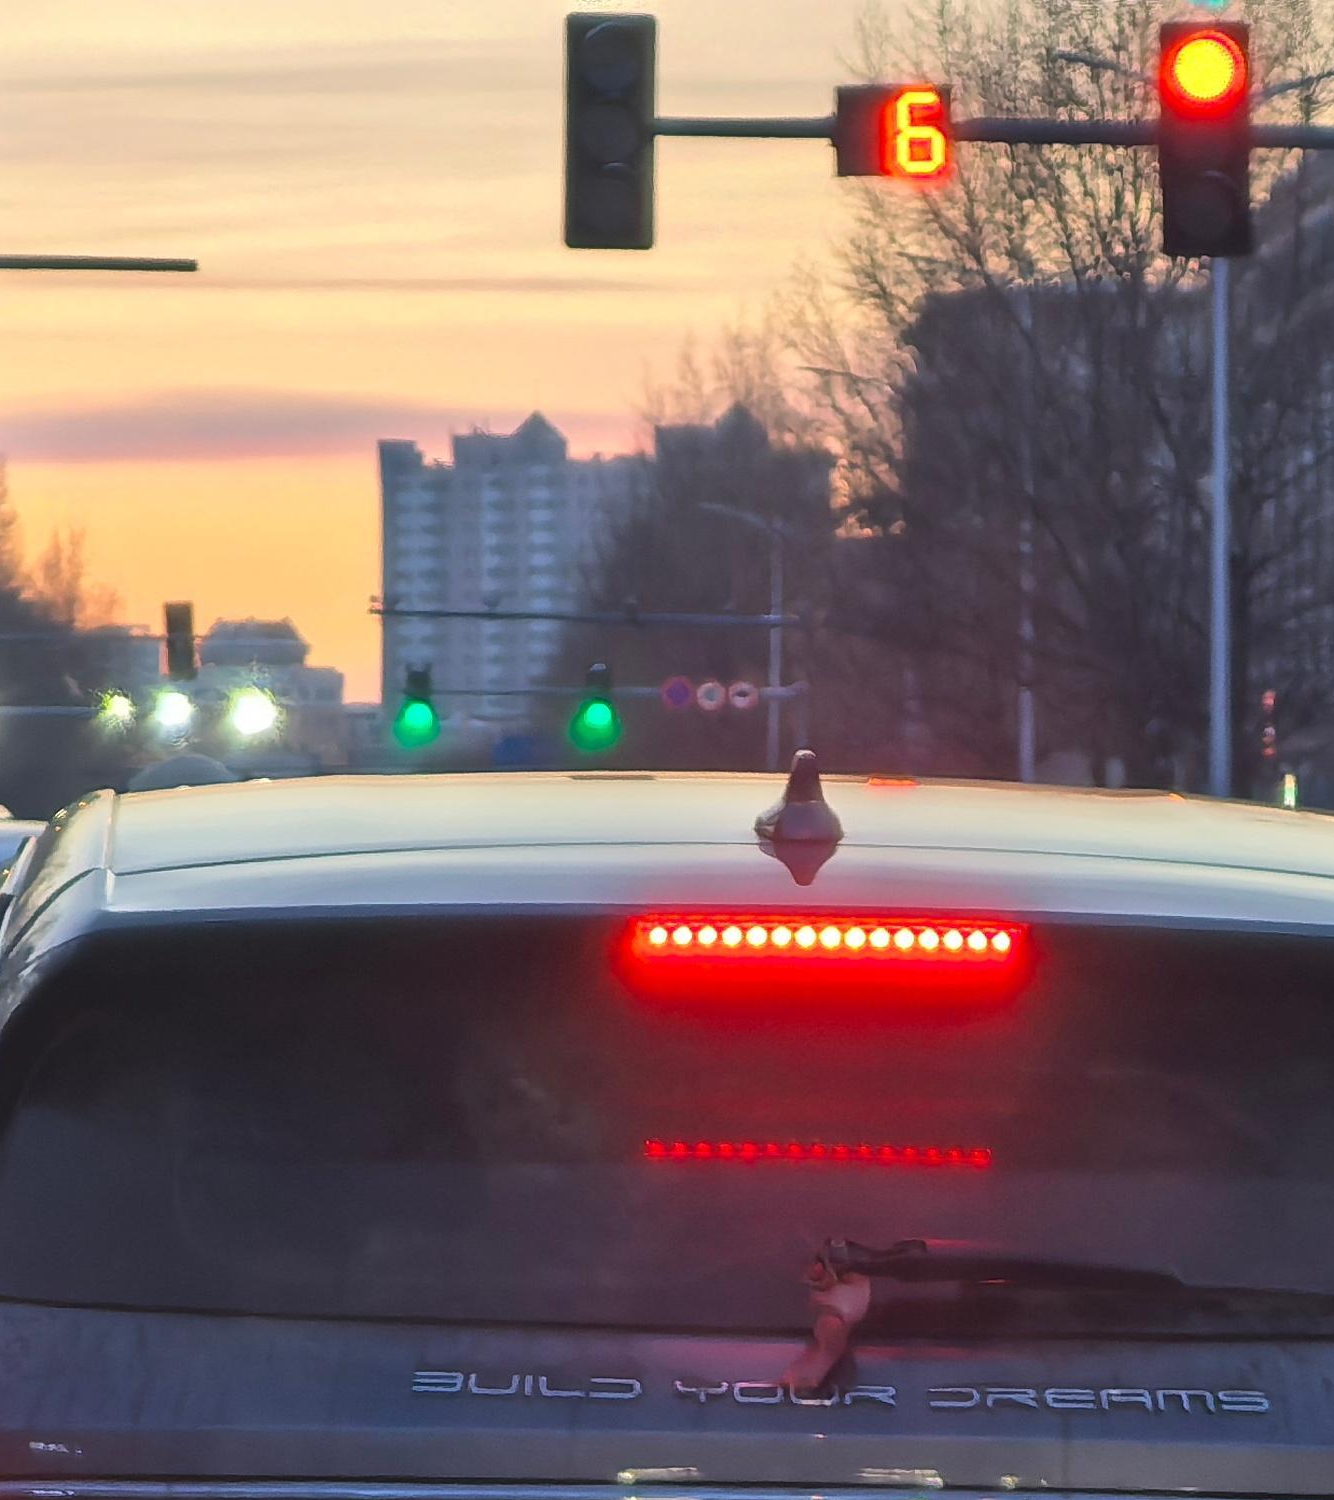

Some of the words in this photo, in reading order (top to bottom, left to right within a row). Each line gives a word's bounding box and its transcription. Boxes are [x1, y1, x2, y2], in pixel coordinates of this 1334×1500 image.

[896, 91, 946, 173] 6
[411, 1369, 641, 1401] BUILD
[673, 1379, 897, 1406] YOUR
[928, 1385, 1272, 1414] DREAMS
